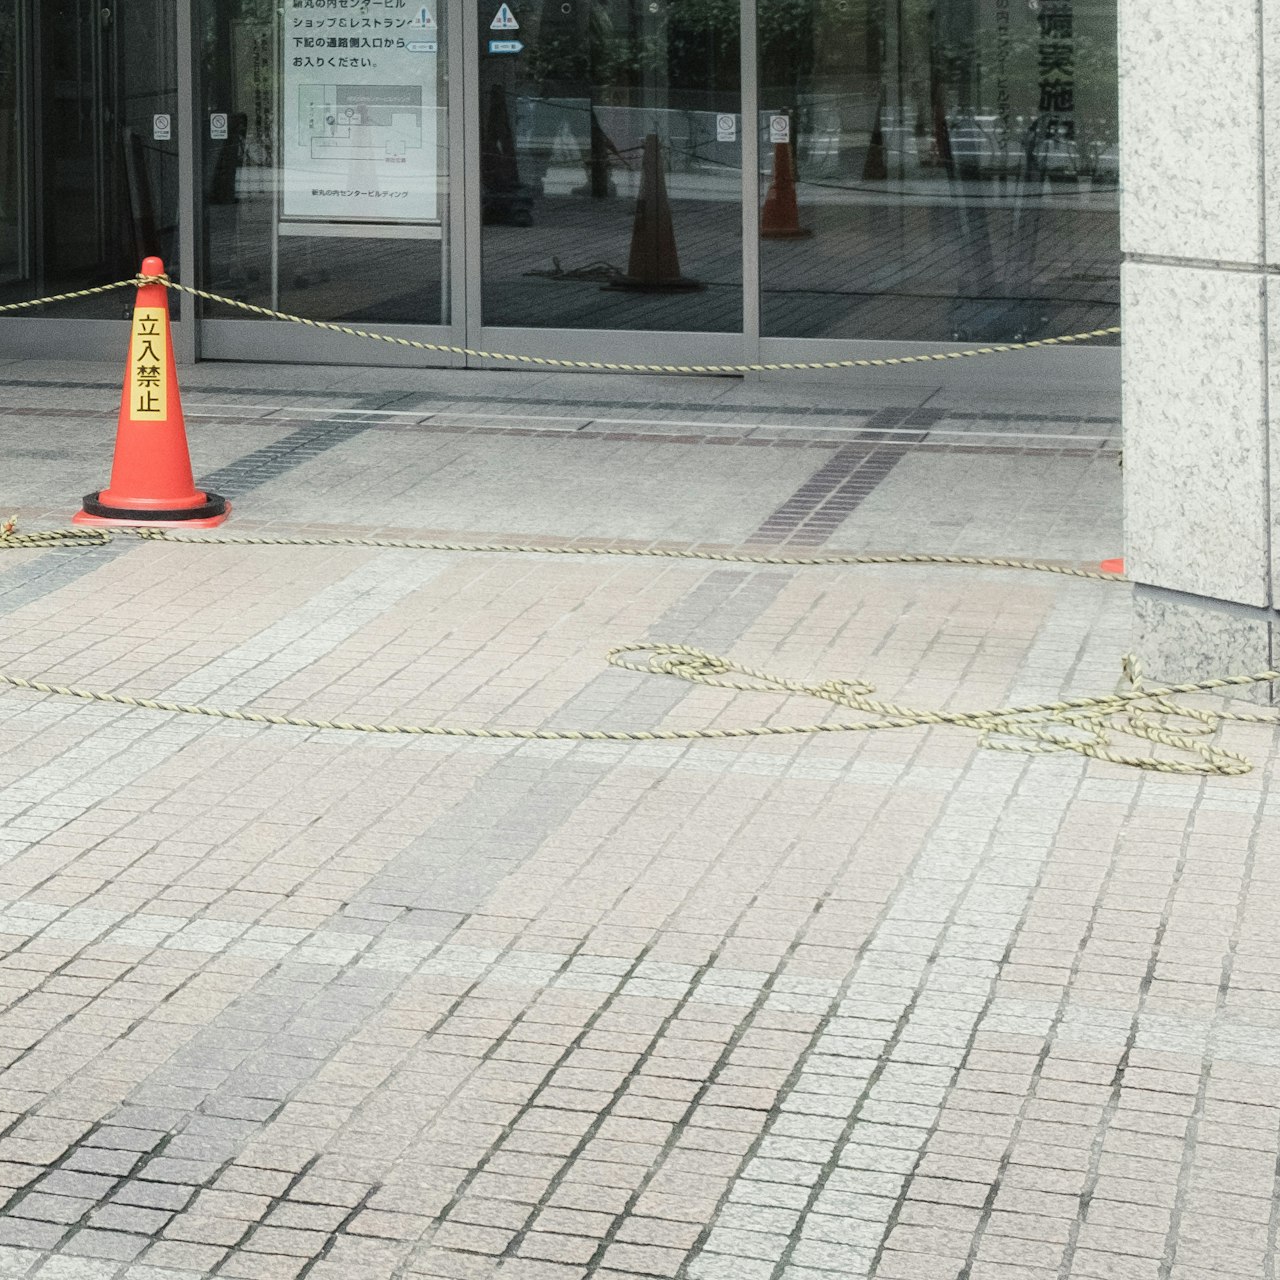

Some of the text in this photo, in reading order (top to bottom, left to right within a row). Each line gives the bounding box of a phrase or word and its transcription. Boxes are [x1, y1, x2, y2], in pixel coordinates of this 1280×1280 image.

[292, 37, 405, 48] 下記の通路側入口から
[292, 57, 378, 67] お入りください。
[311, 189, 408, 198] 新丸の内センタービルディング
[137, 314, 160, 412] 立入禁止
